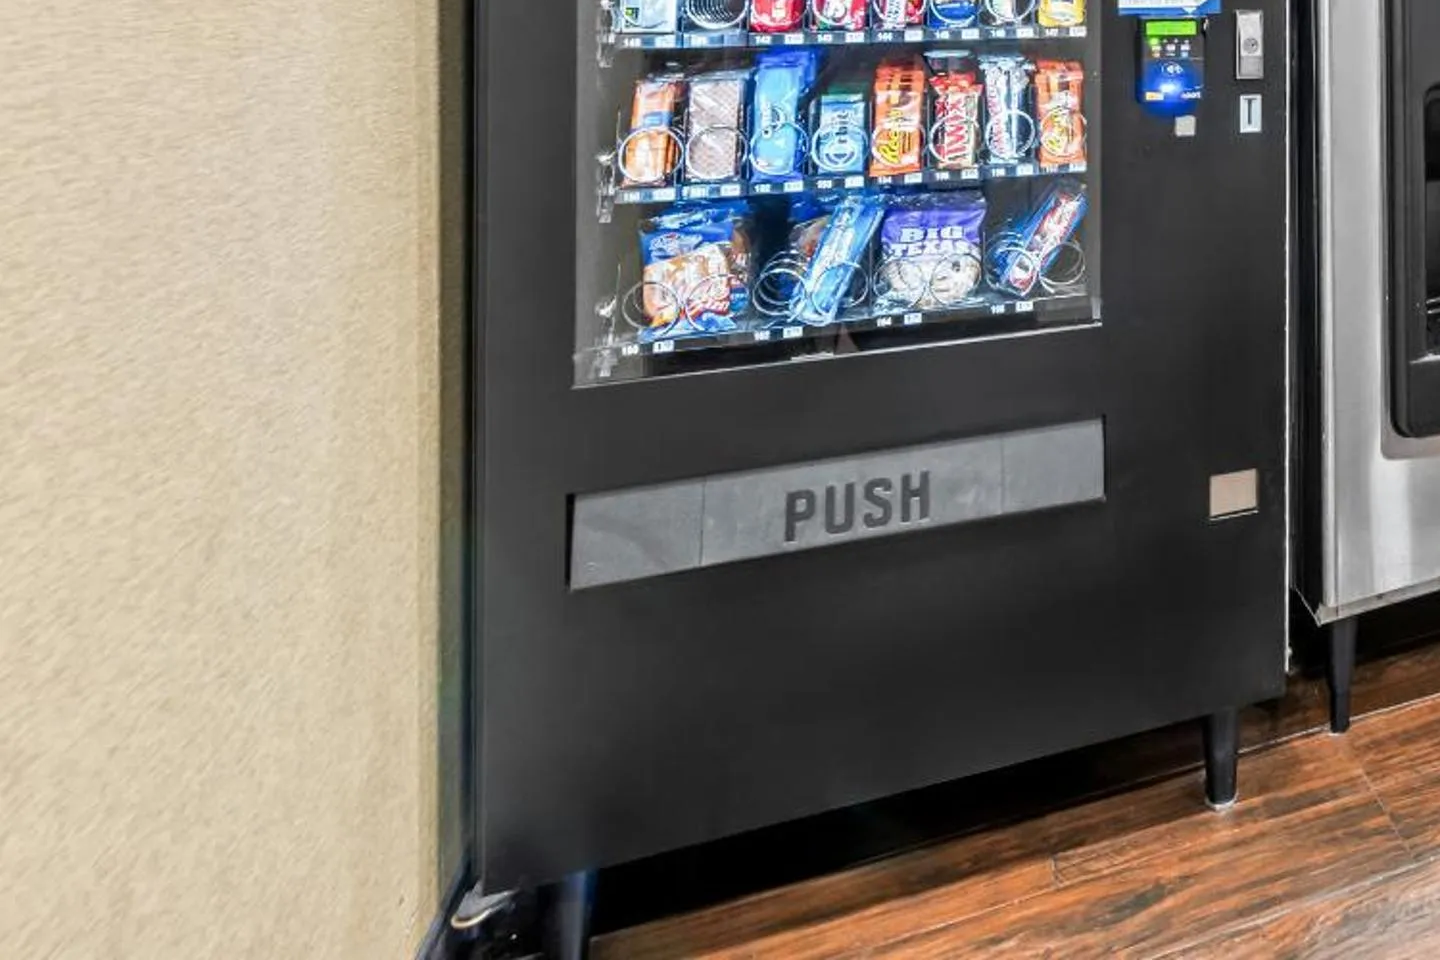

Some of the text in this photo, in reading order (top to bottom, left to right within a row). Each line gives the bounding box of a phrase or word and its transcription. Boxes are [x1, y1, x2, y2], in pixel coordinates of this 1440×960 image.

[900, 226, 964, 243] BIG
[890, 241, 974, 256] TEXAS
[783, 470, 931, 543] PUSH
